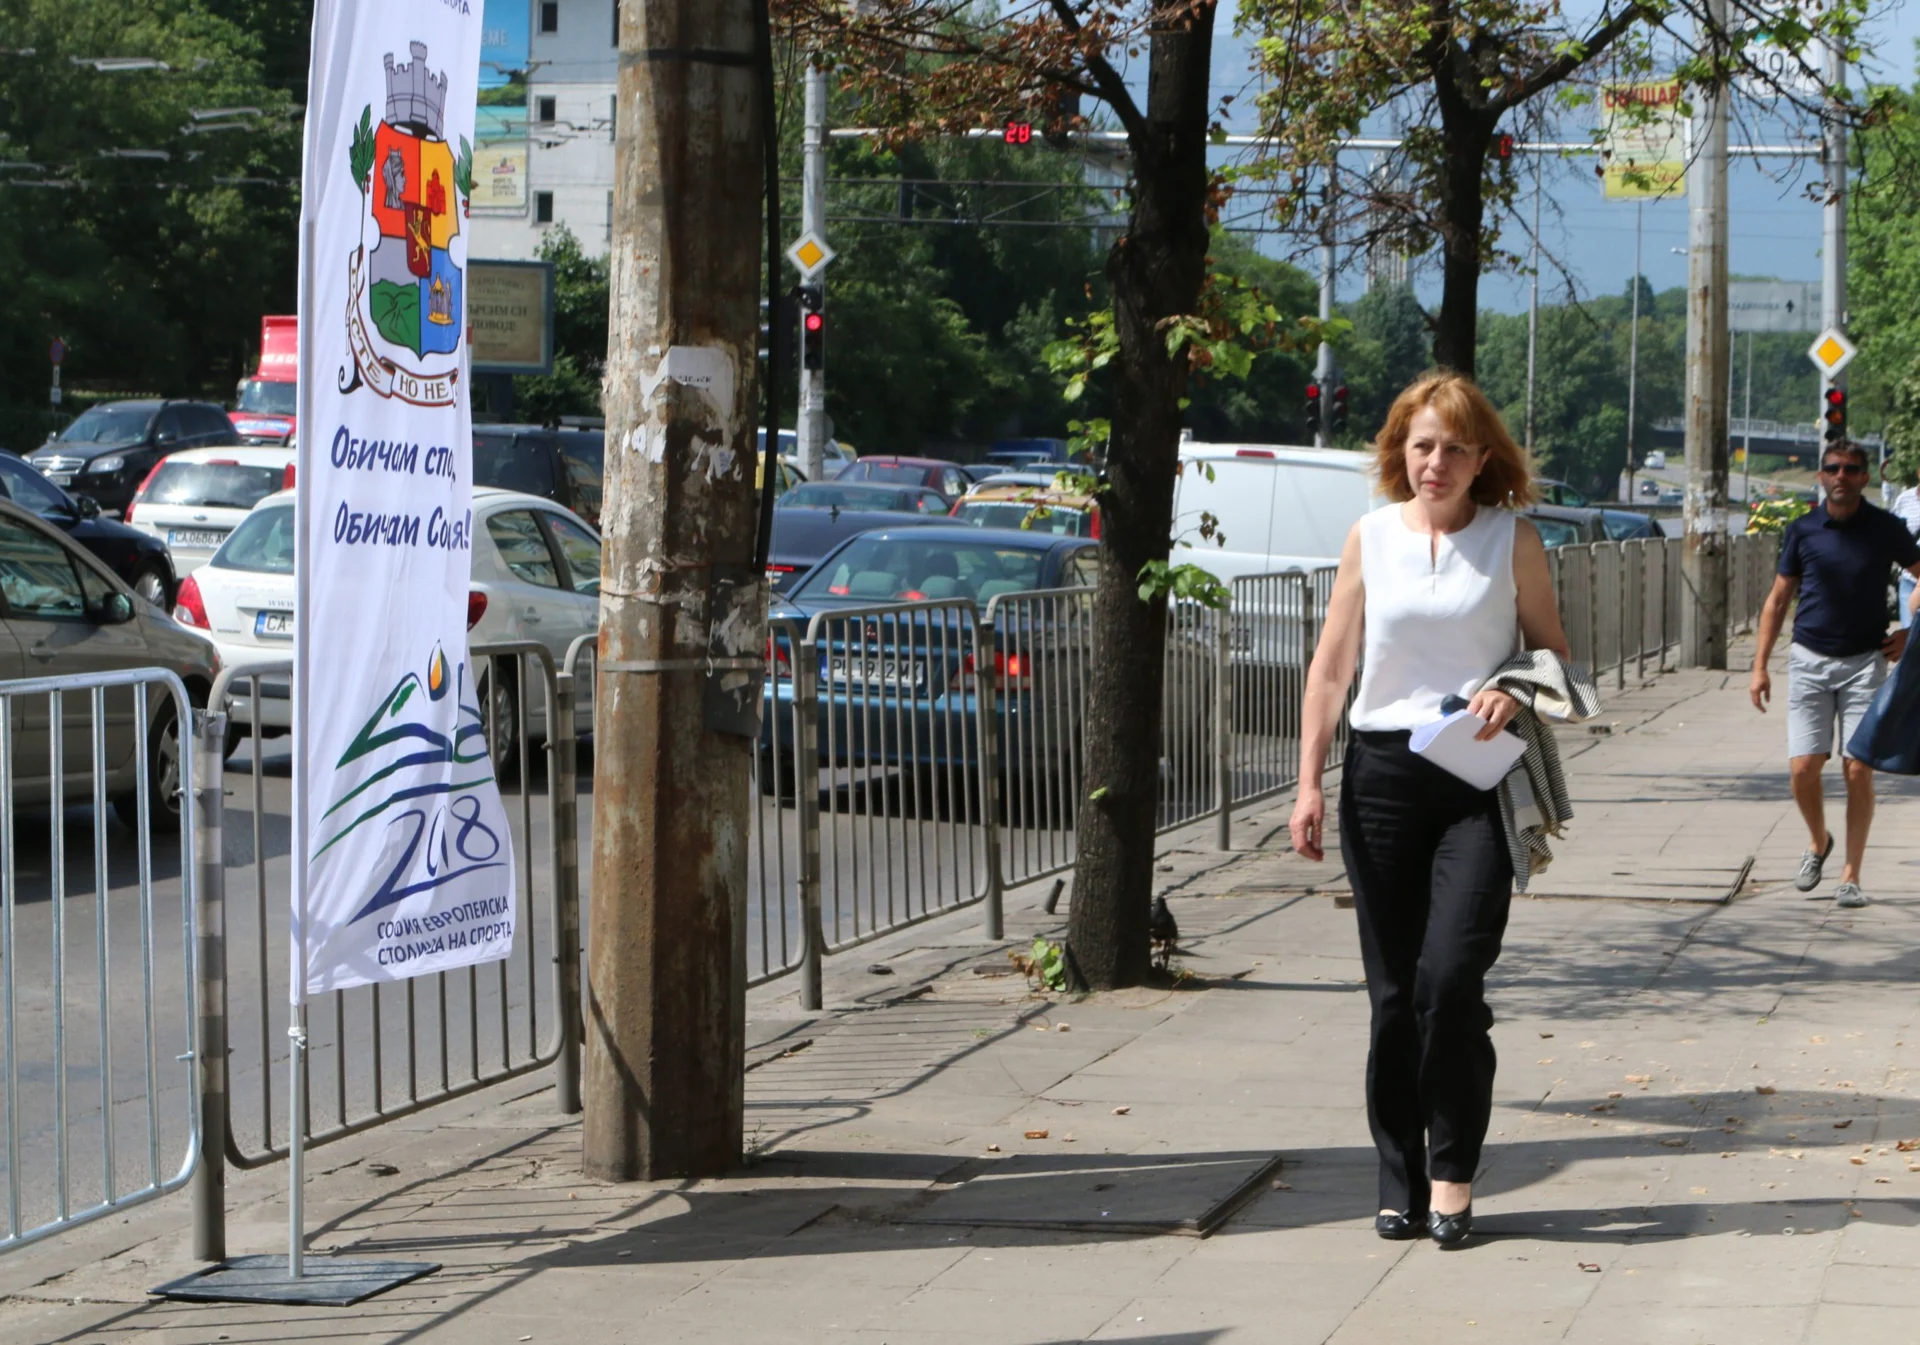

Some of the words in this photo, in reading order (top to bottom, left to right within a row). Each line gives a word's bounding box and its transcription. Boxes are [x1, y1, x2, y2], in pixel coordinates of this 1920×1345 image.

[468, 304, 508, 316] ЪРСИМ
[399, 375, 418, 395] НО
[424, 382, 448, 400] НЕ
[448, 931, 467, 949] НА
[469, 921, 512, 945] СПОРТА
